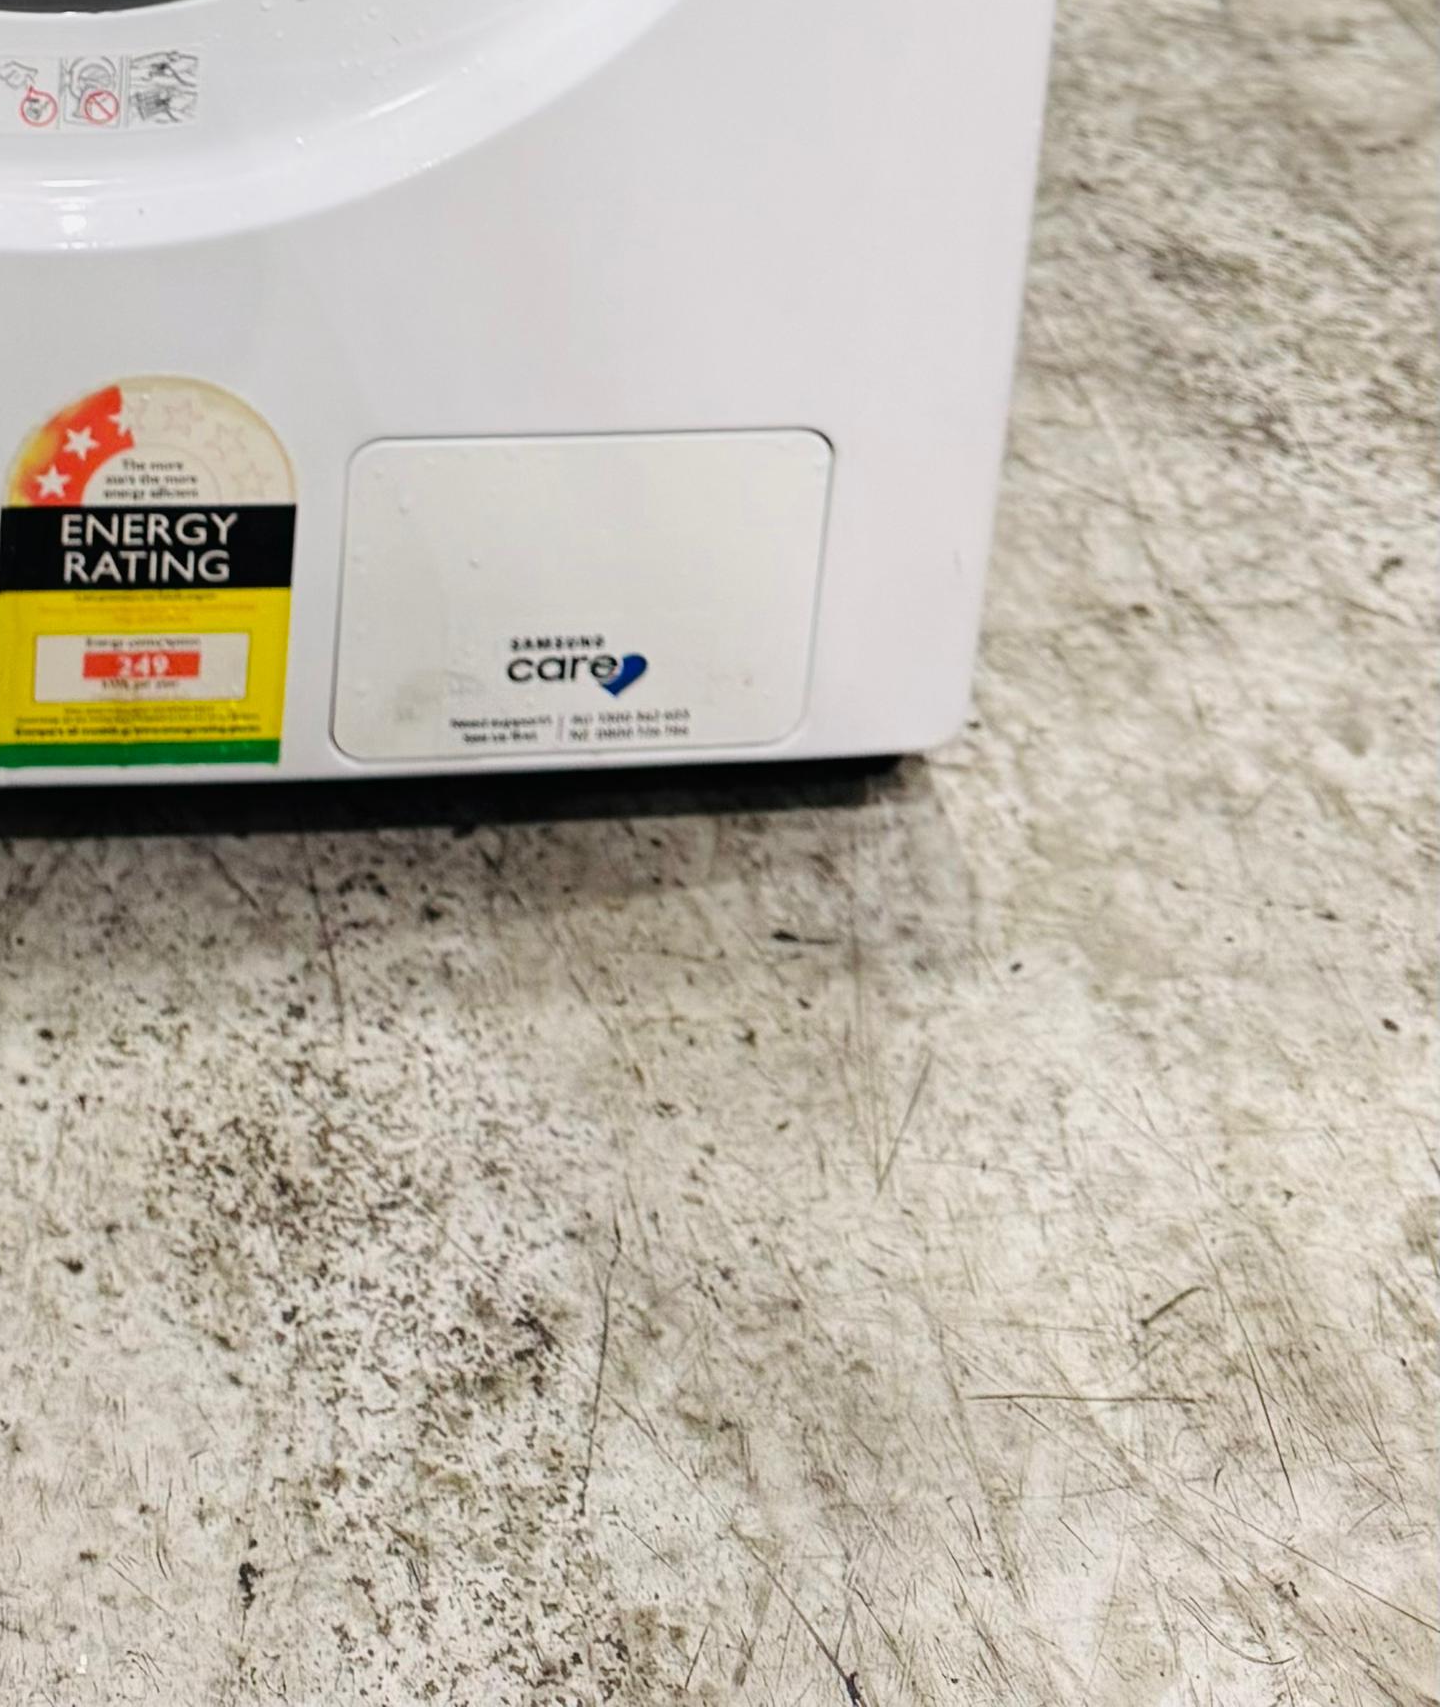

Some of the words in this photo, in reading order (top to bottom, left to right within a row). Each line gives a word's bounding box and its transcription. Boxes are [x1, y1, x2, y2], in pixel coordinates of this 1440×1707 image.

[61, 513, 237, 546] ENERGY
[64, 550, 230, 583] RATING
[511, 634, 605, 651] SAMSUNG
[507, 654, 618, 683] care
